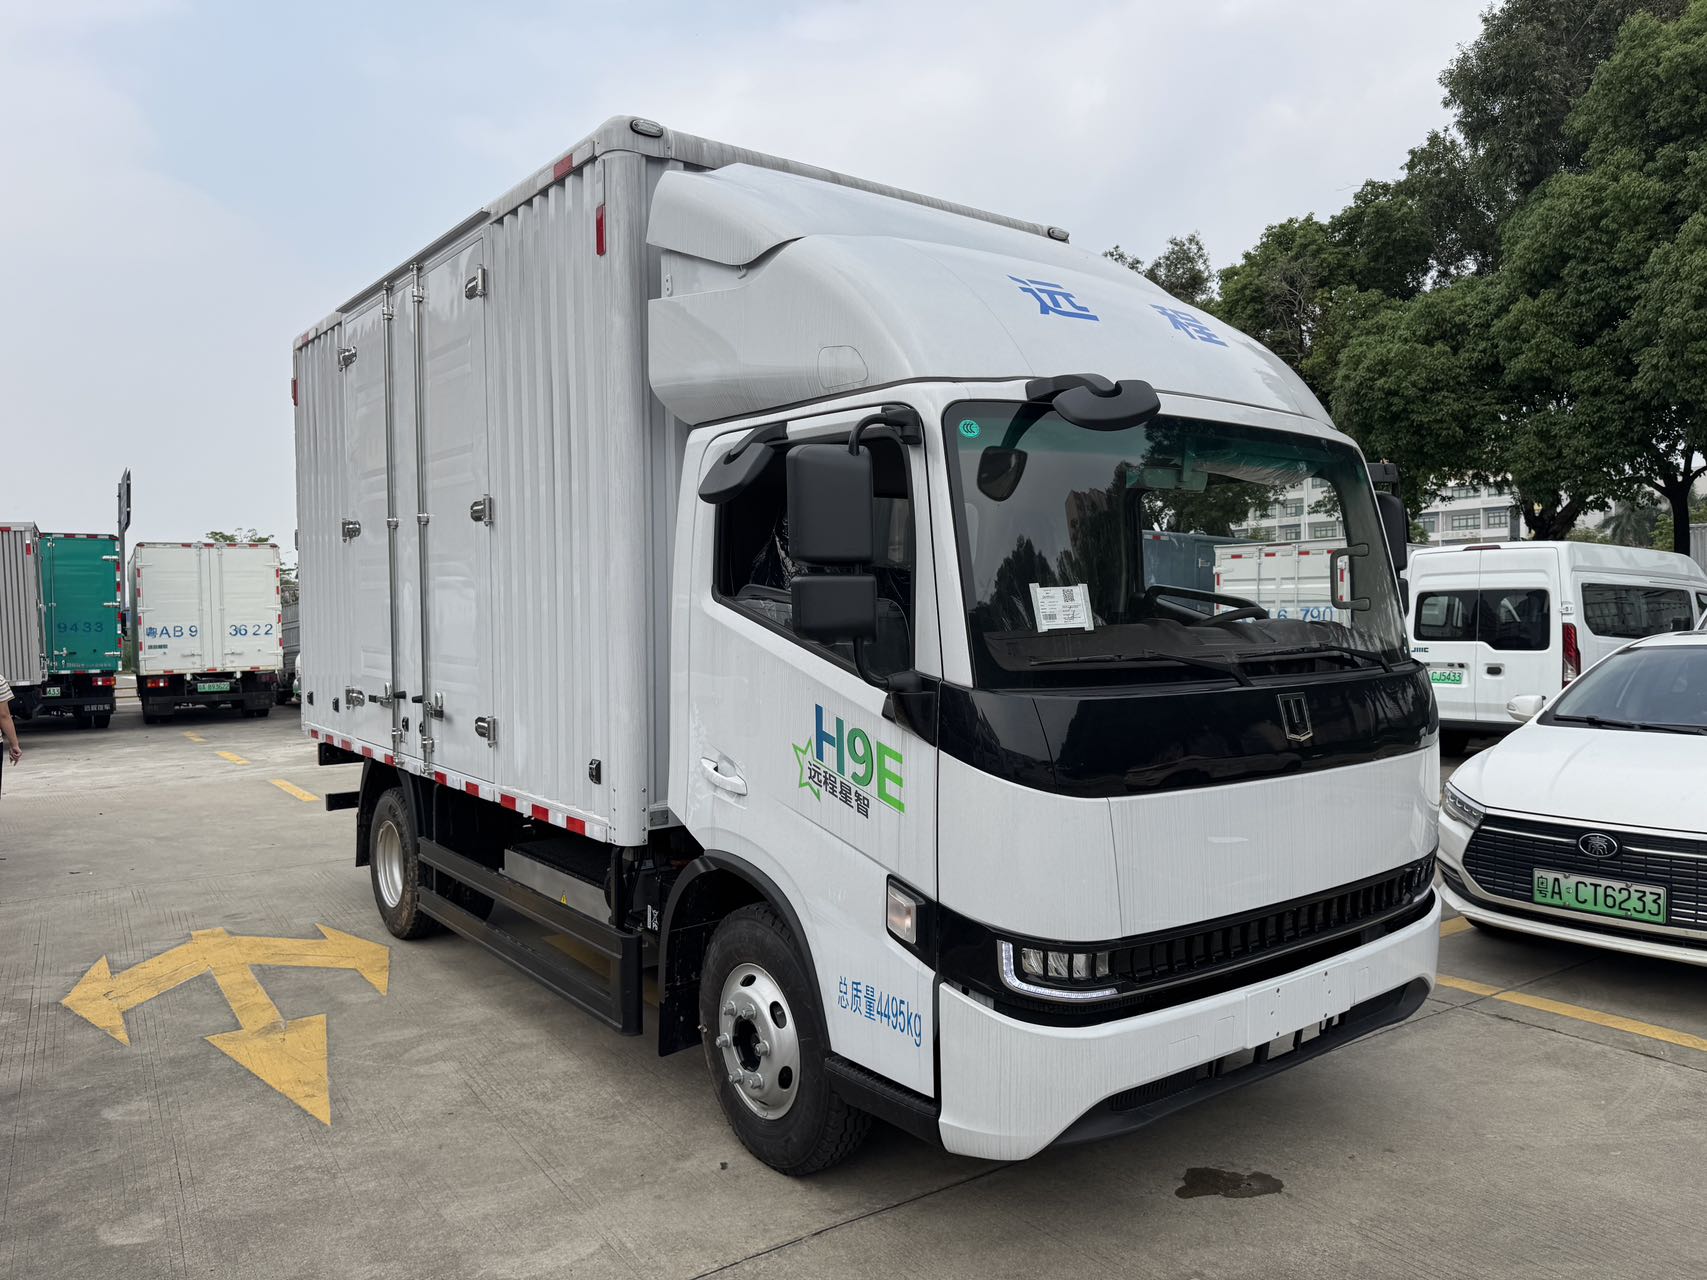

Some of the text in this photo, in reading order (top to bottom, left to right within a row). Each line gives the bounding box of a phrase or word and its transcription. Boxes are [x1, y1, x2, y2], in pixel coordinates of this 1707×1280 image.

[57, 622, 104, 633] 9433
[229, 623, 273, 636] 3622
[815, 703, 905, 813] H9E
[808, 761, 870, 818] 远程星智
[1575, 880, 1662, 917] CT6233
[837, 975, 922, 1047] 总质量4495kg
